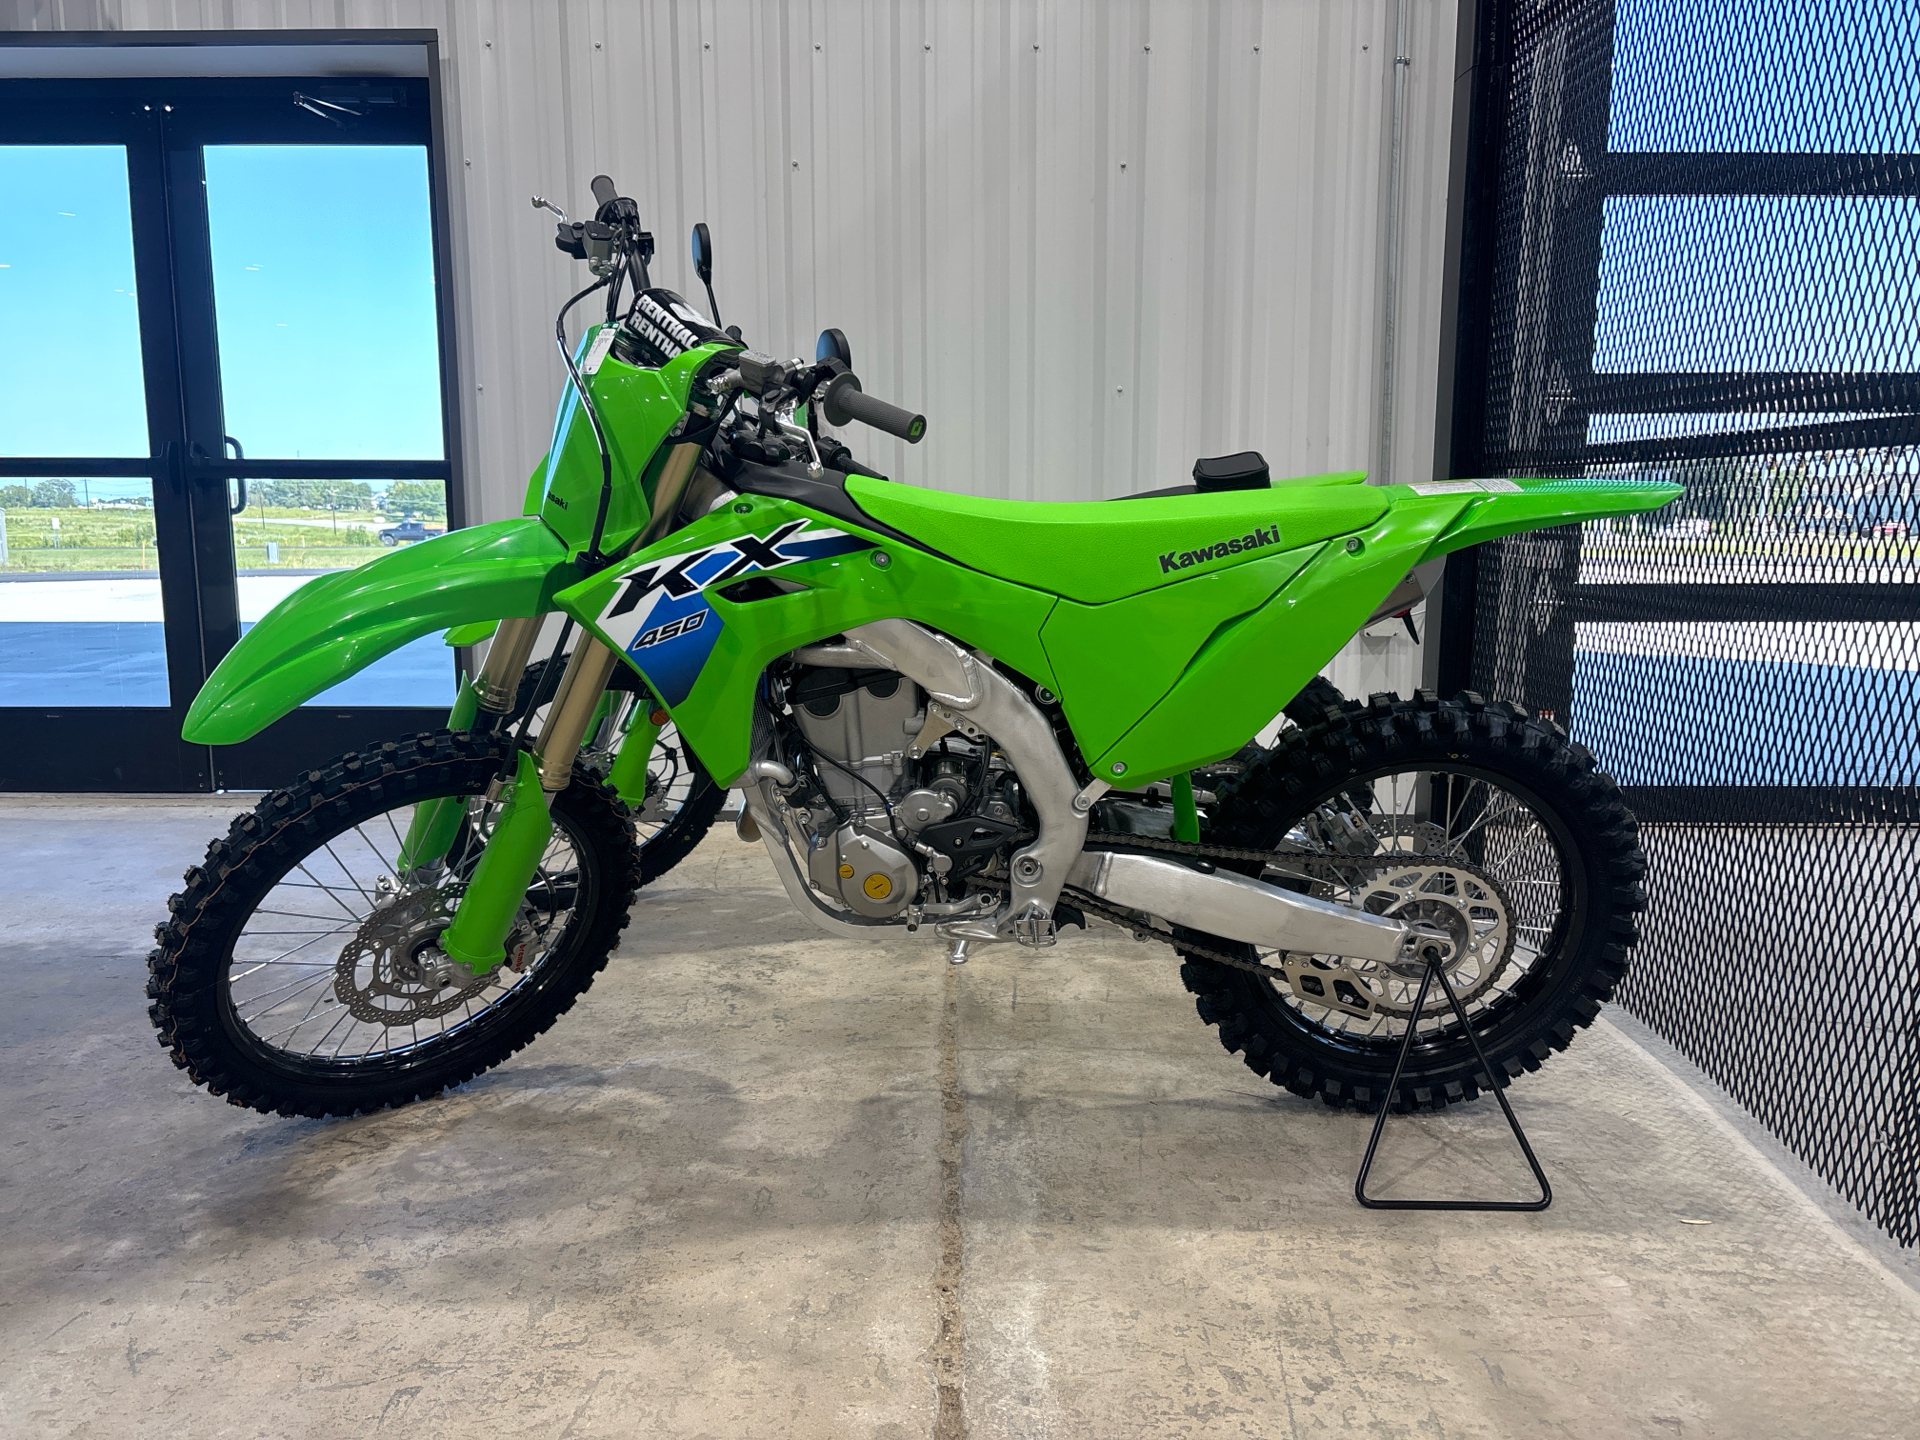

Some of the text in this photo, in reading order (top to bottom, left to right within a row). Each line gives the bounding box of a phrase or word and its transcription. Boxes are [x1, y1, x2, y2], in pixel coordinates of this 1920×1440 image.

[628, 311, 682, 359] RENTHA
[547, 490, 569, 510] asaki
[606, 518, 810, 620] KX
[1159, 524, 1281, 574] Kawasaki
[632, 609, 708, 650] 450
